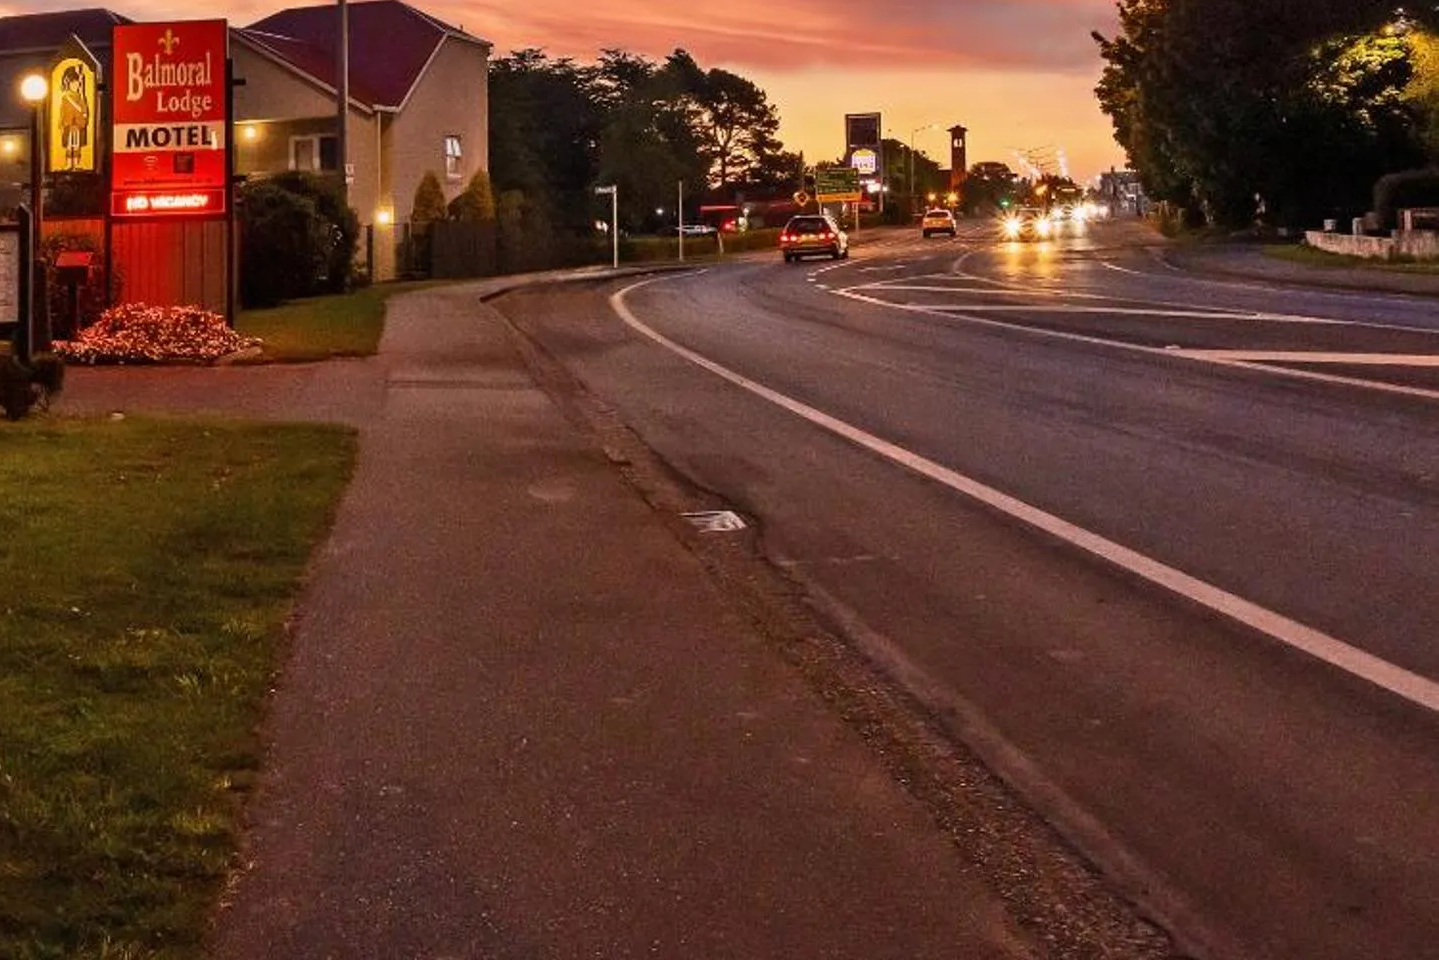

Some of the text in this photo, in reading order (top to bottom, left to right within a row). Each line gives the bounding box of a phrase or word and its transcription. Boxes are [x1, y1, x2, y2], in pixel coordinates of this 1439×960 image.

[126, 49, 212, 101] Balmoral
[156, 89, 213, 119] Lodge
[126, 125, 214, 148] MOTEL
